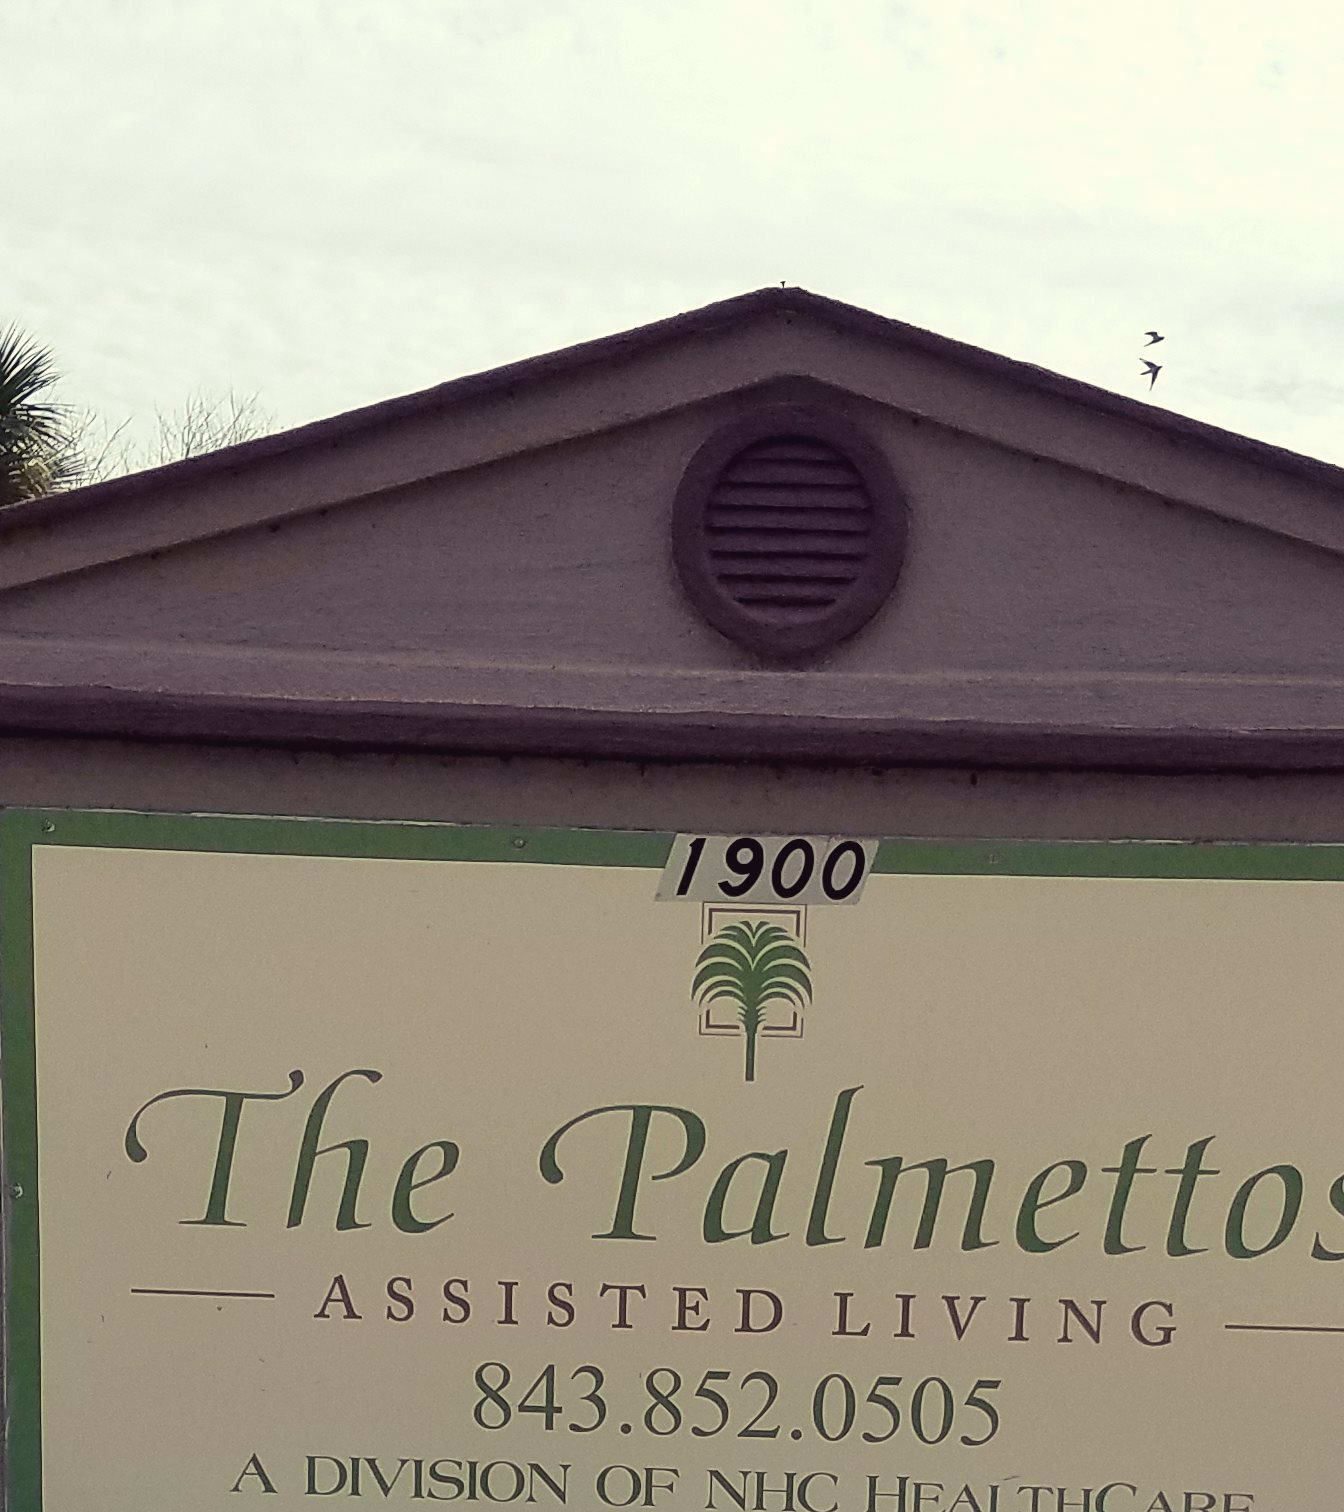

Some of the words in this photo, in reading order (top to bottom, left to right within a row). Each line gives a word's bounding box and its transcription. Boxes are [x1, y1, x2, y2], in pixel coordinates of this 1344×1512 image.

[676, 837, 865, 900] 1900
[124, 1069, 460, 1234] The
[313, 1274, 784, 1333] ASSISTED
[832, 1291, 1178, 1348] LIVING
[474, 1362, 1002, 1447] 843.852.0505
[230, 1453, 278, 1495] A
[305, 1455, 571, 1505] DIVISION
[596, 1465, 680, 1507] OF
